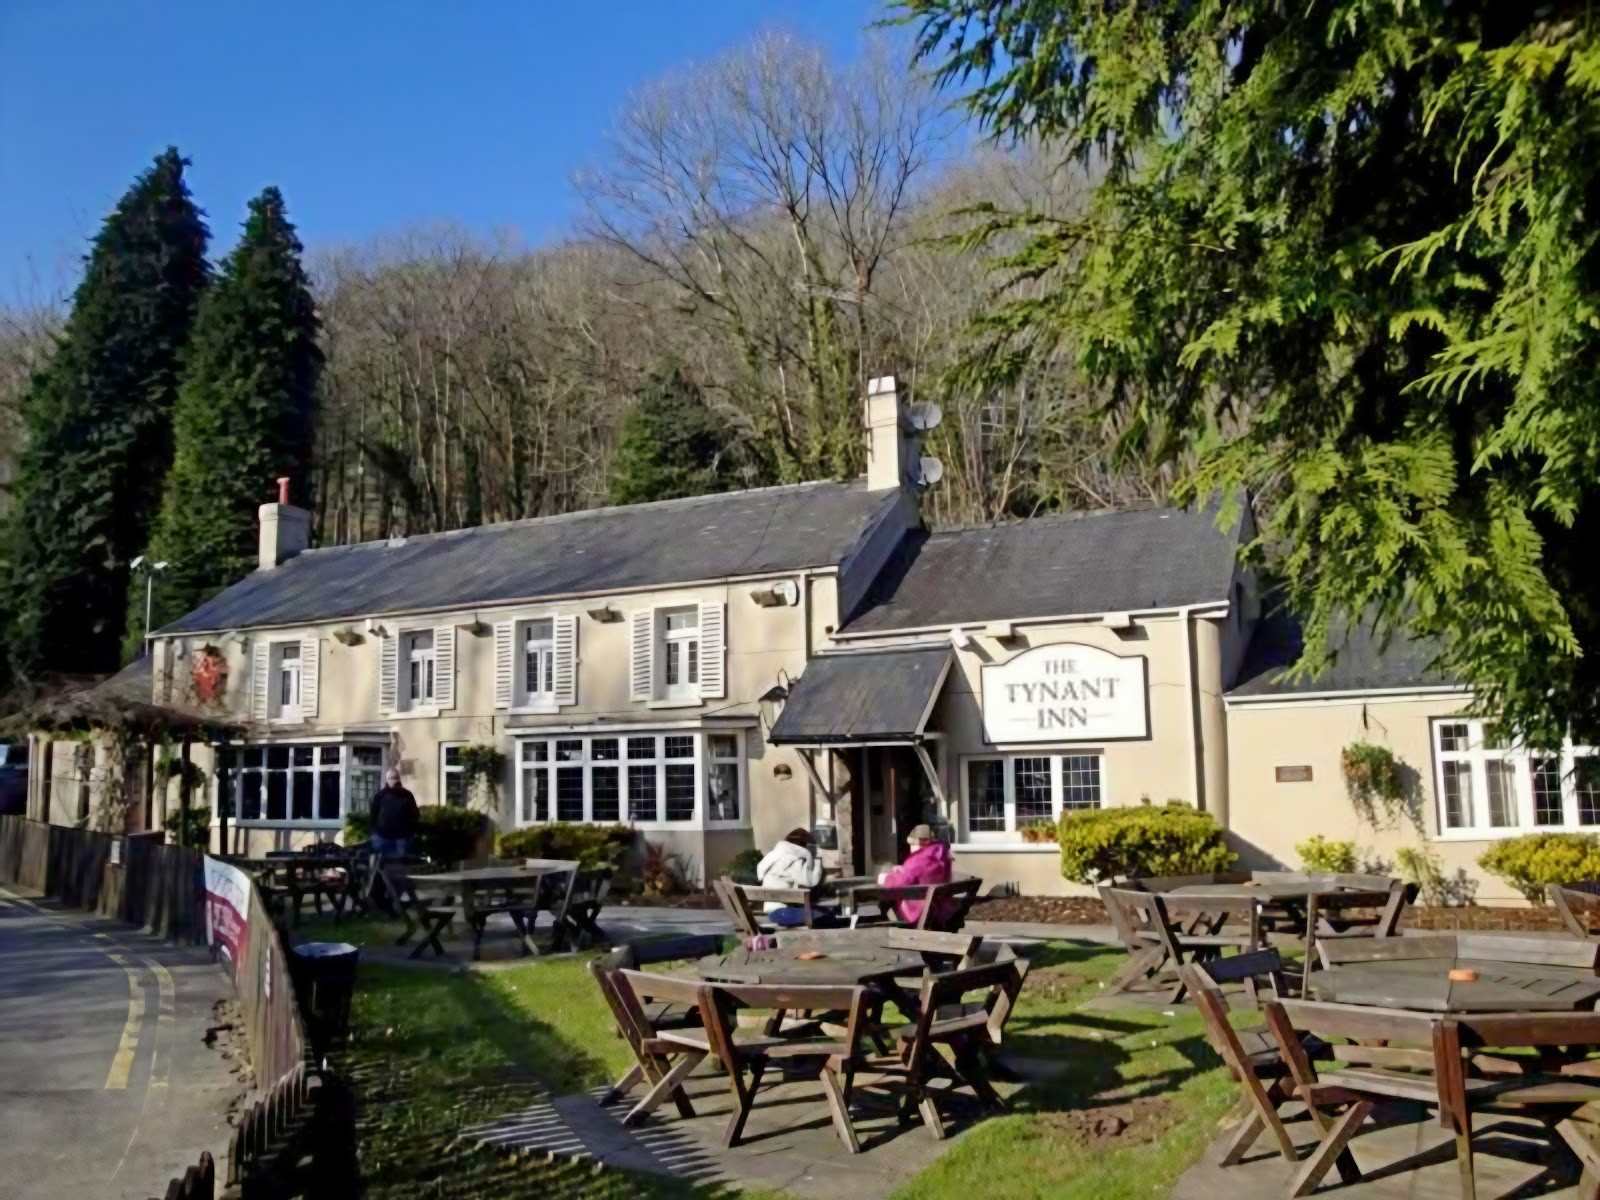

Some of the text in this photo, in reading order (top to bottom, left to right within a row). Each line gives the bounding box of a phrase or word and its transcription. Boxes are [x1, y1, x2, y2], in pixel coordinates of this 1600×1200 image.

[1045, 659, 1078, 674] THE
[1006, 678, 1120, 703] TYNANT
[1038, 708, 1087, 729] INN
